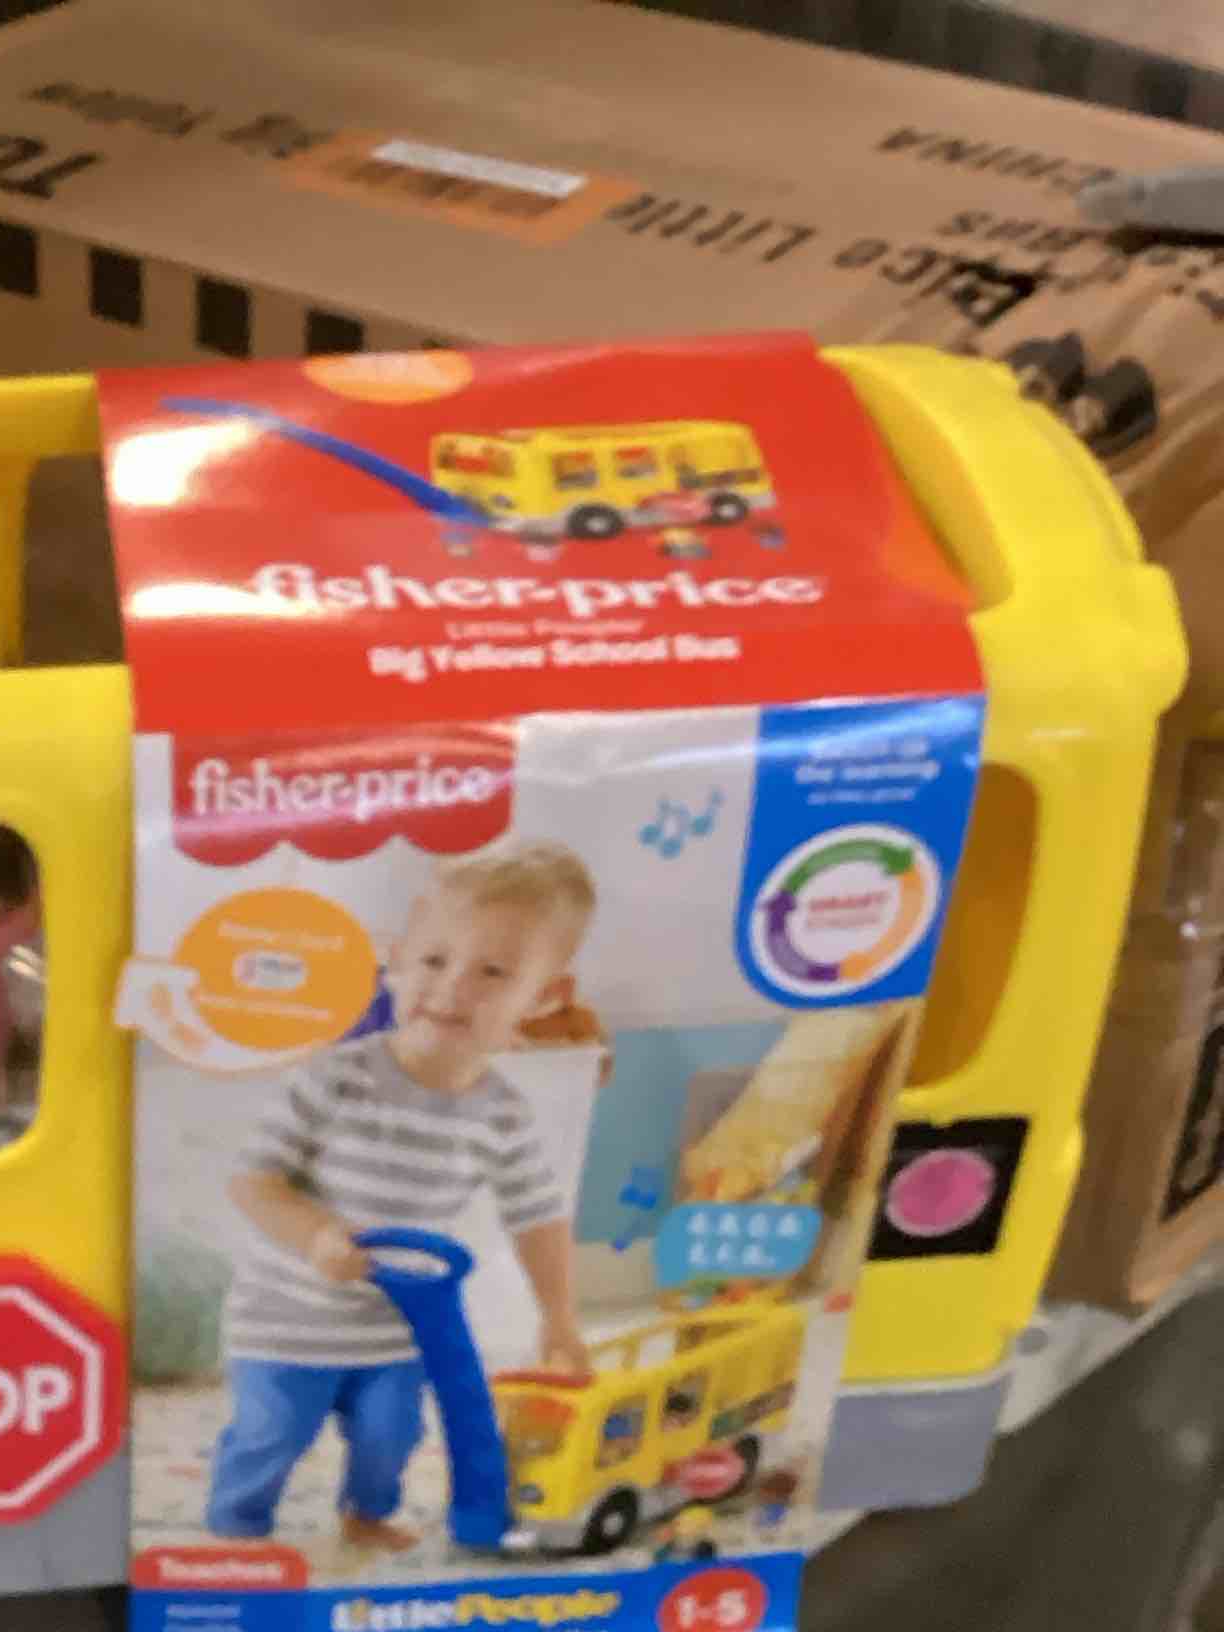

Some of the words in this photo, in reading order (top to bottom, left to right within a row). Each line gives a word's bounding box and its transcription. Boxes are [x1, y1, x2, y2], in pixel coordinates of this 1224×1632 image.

[252, 562, 827, 617] fisher-price
[367, 645, 427, 683] Big
[432, 642, 544, 673] Yellow
[551, 636, 667, 667] School
[674, 633, 740, 661] Bus
[189, 754, 494, 822] fisher-price
[678, 1589, 748, 1629] 1-5
